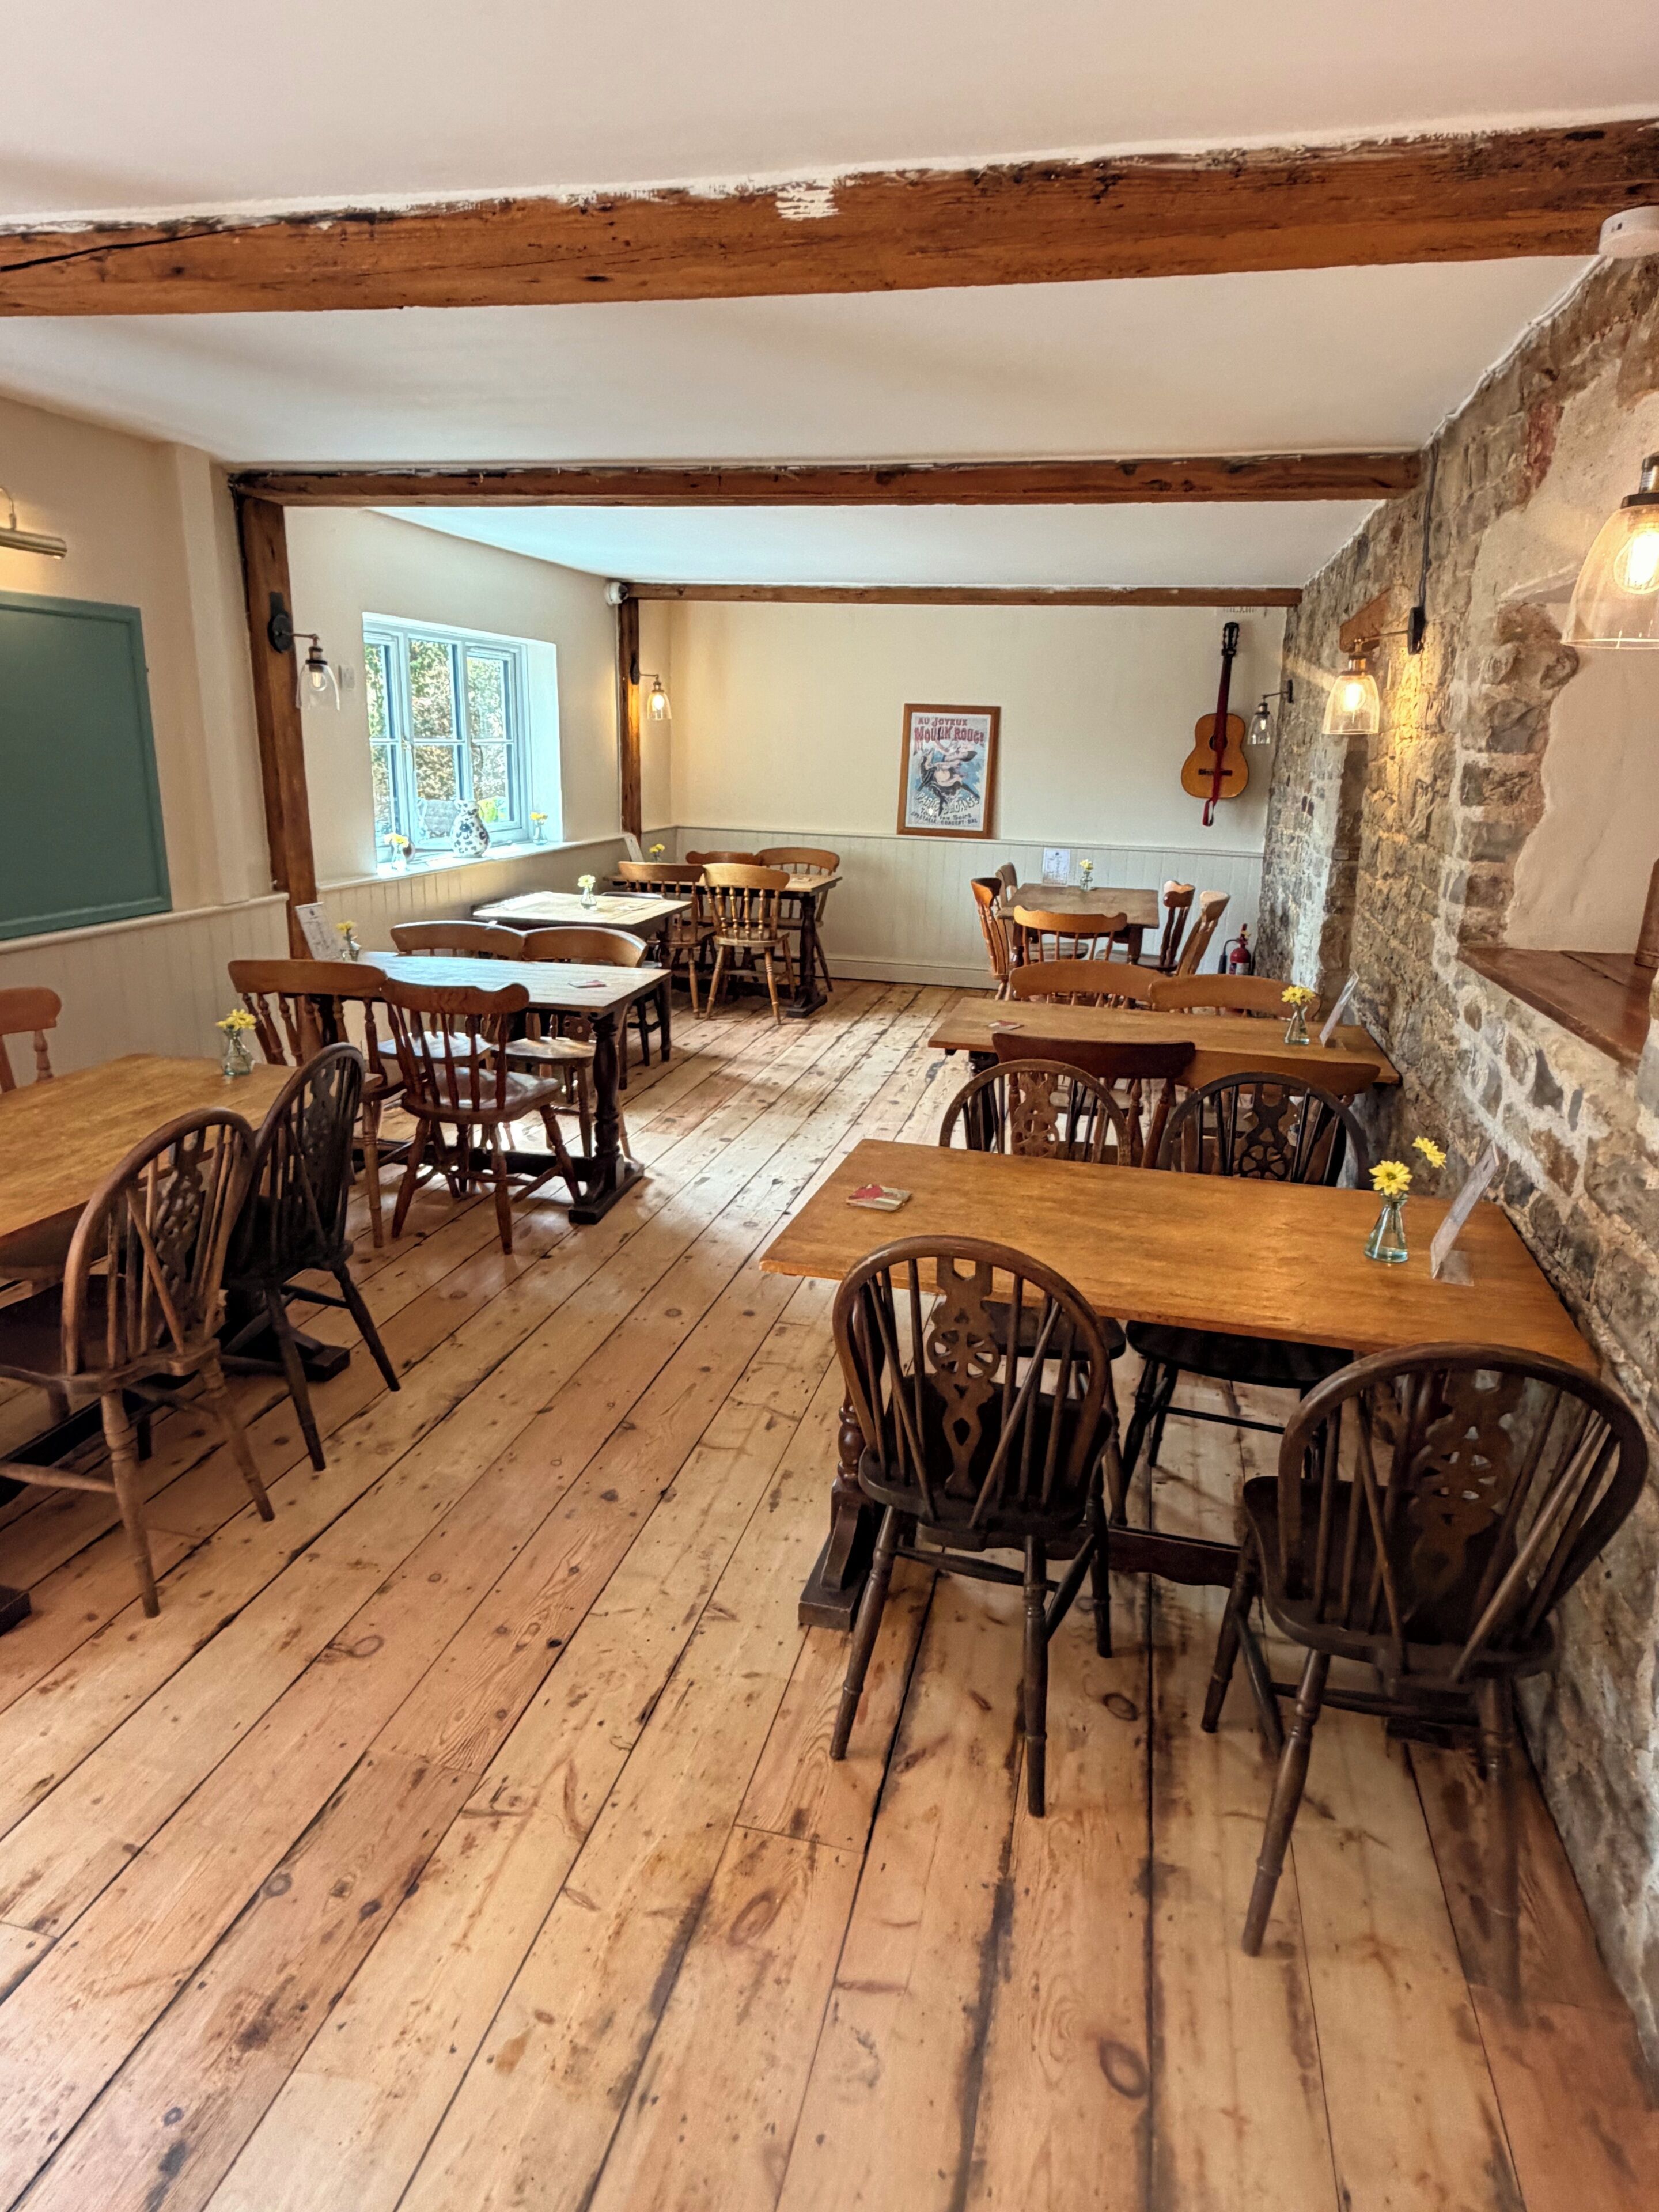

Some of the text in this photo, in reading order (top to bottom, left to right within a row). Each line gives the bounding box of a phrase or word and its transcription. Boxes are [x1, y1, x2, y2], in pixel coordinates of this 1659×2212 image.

[932, 717, 968, 727] JOYEUX
[914, 726, 985, 744] MOULIN ROUGE
